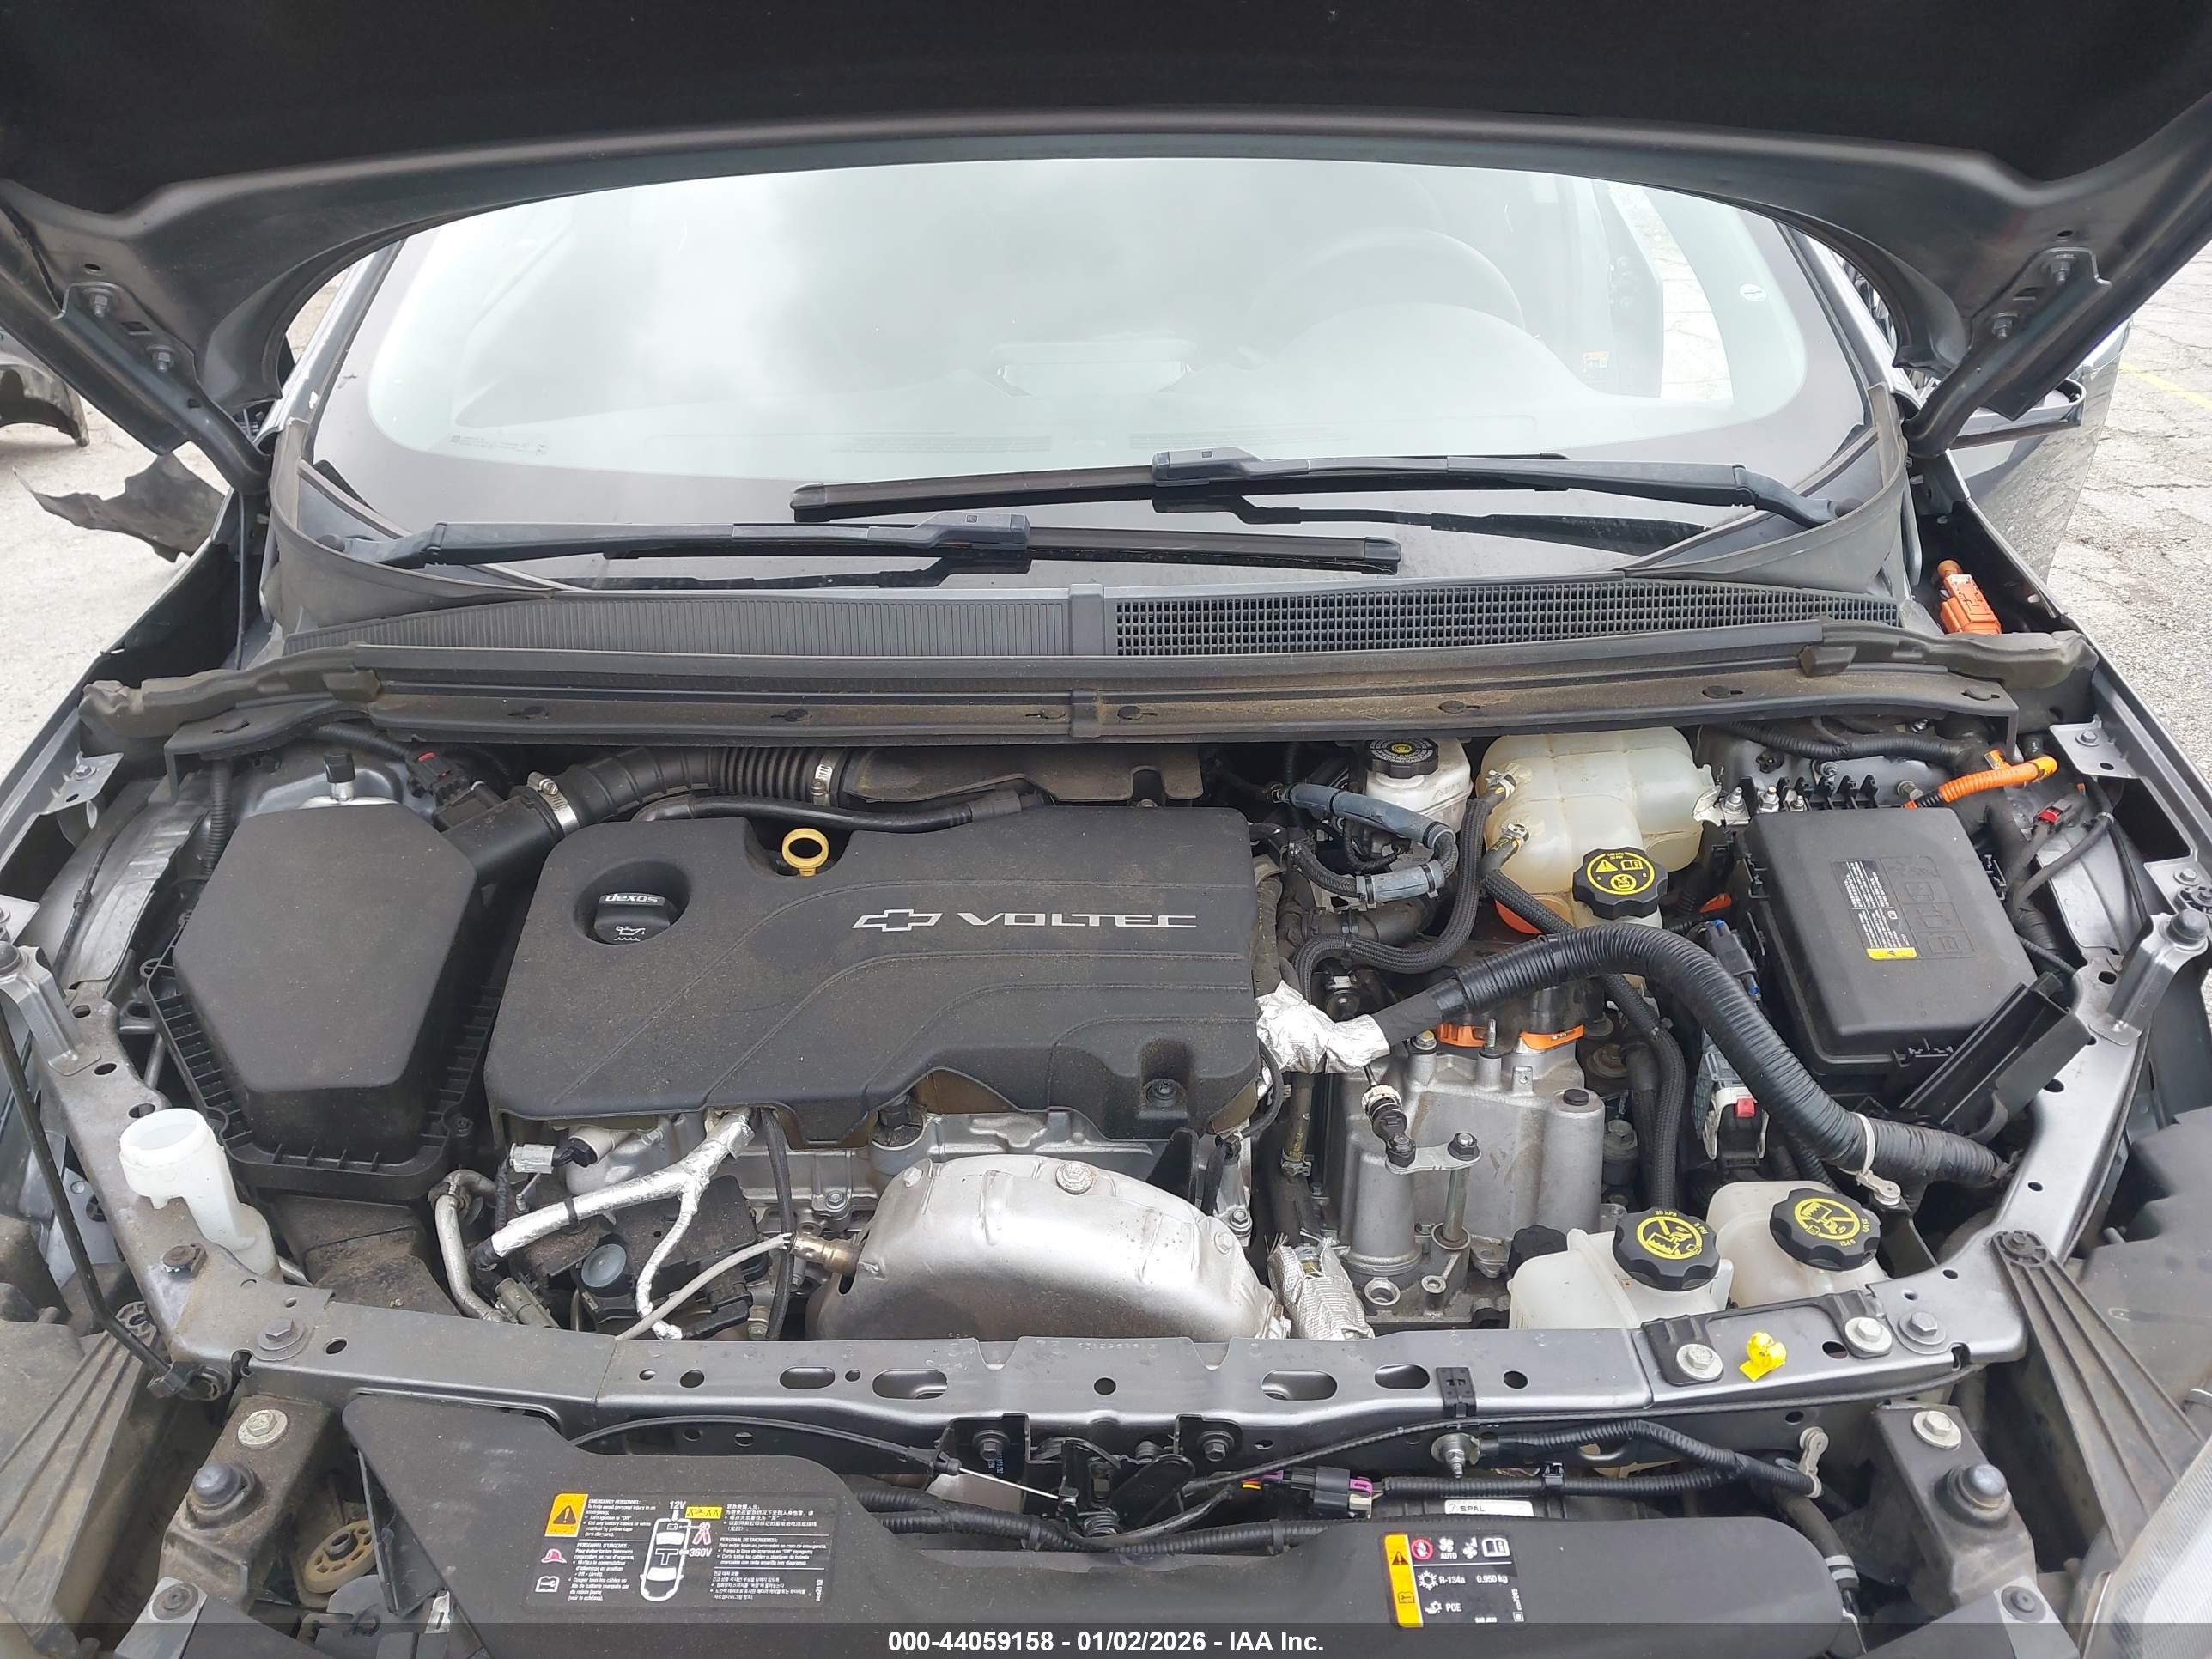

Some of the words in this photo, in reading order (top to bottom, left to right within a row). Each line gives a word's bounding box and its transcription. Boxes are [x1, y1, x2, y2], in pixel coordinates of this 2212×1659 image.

[605, 894, 659, 903] dexos
[957, 912, 1197, 928] VOLTEC
[1476, 1575, 1498, 1583] 0.950
[1498, 1575, 1508, 1583] kg
[1446, 1603, 1462, 1613] POE
